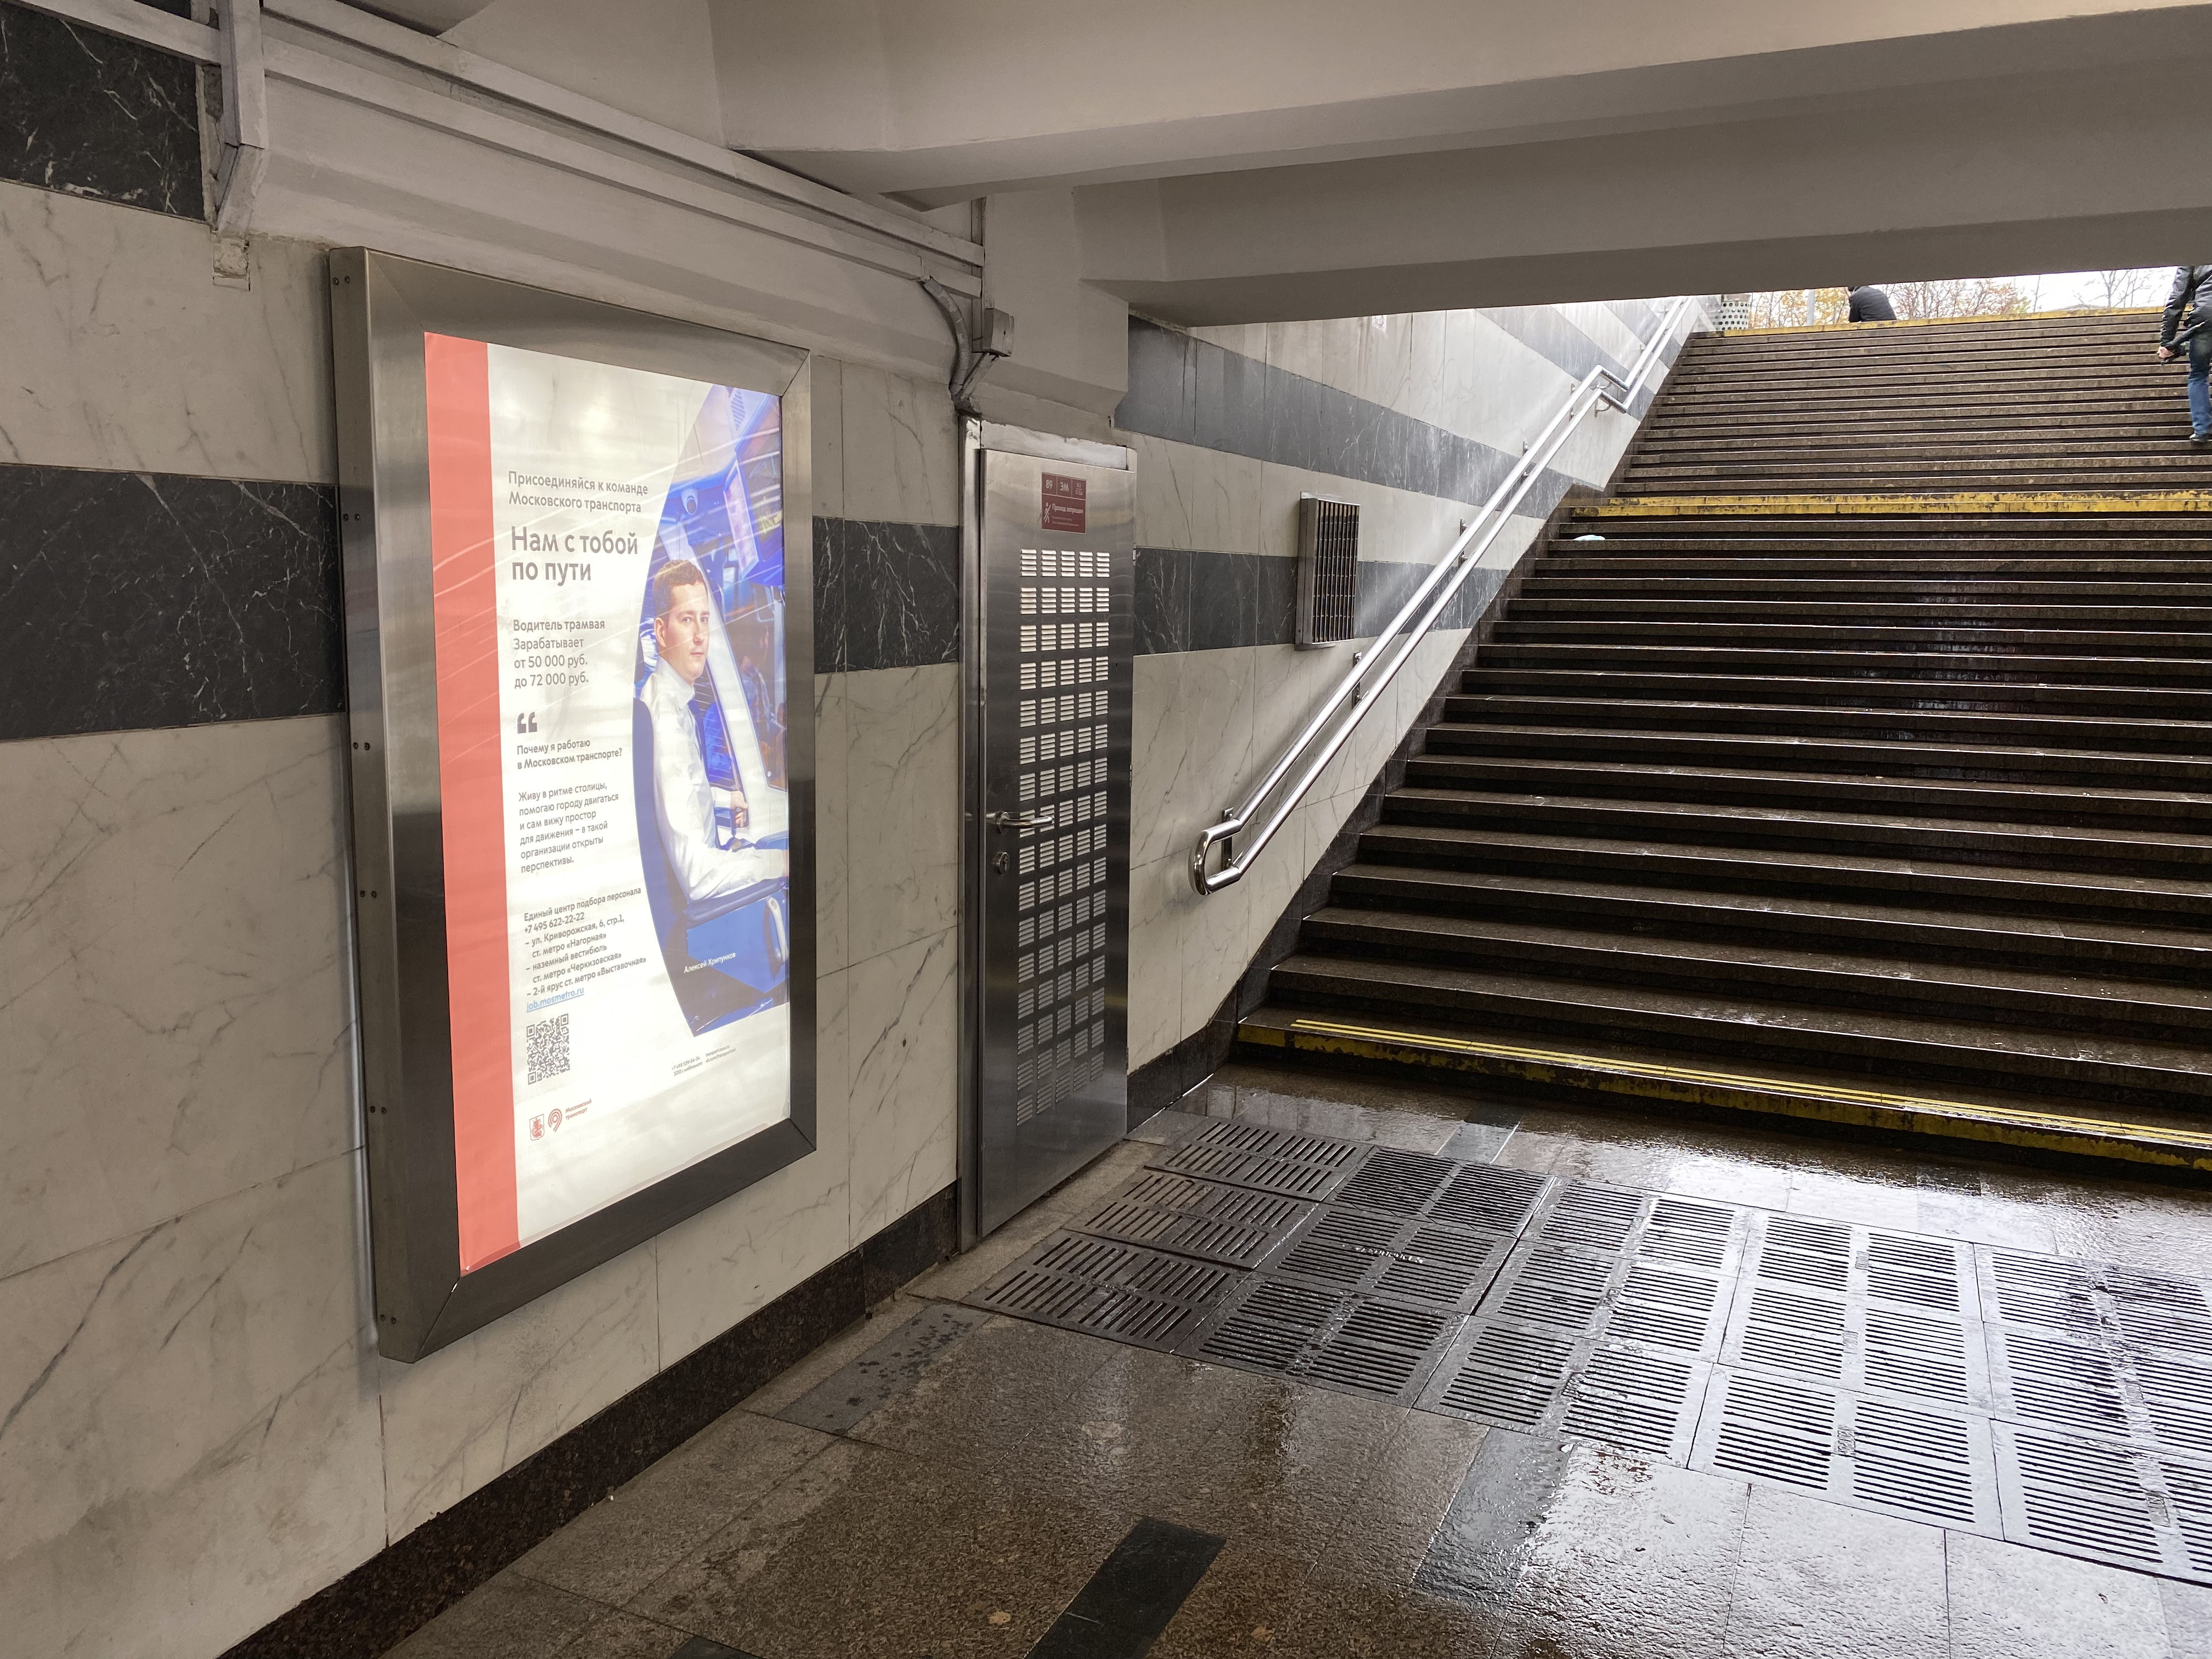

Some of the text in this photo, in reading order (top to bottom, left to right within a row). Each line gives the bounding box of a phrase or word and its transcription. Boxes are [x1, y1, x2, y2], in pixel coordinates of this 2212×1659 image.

[509, 471, 648, 496] Присоединяйся к команде
[1046, 479, 1052, 489] 89
[509, 492, 641, 514] Московского транспорта
[511, 526, 637, 554] Нам с тобой
[512, 562, 591, 586] по пути
[513, 619, 605, 633] Водитель трамвая
[514, 637, 584, 652] Зарабатывает
[515, 653, 588, 668] от 50 000 руб.
[515, 672, 588, 689] до 72 000 руб.
[517, 744, 548, 755] Почему
[557, 740, 590, 752] работаю
[524, 756, 575, 769] Московском
[577, 748, 622, 763] транспорте?
[518, 792, 540, 802] Живу
[549, 787, 572, 799] ритме
[575, 783, 607, 793] столицы,
[520, 794, 618, 816] помогаю городу двигаться
[527, 820, 541, 828] сам
[544, 816, 563, 828] вижу
[566, 811, 596, 822] простор
[520, 836, 533, 846] для
[535, 829, 573, 843] движения
[588, 821, 607, 832] такой
[521, 837, 603, 860] организации открыты
[521, 856, 574, 873] перспективы.
[524, 888, 641, 922] Единый центр подбора персонала
[524, 912, 584, 934] +7 495 622-22-22
[532, 938, 542, 947] ул.
[544, 923, 597, 943] Криворожская,
[543, 943, 565, 955] метро
[567, 933, 607, 949] «Нагорная»
[533, 953, 568, 970] наземный
[571, 945, 607, 960] вестибюль
[544, 968, 565, 980] метро
[567, 953, 621, 973] «Черкизовская»
[684, 952, 736, 973] Алексей Хрипунков
[533, 986, 545, 996] 2-й
[547, 981, 563, 992] ярус
[575, 972, 596, 983] метро
[597, 957, 646, 977] «Выставочная»
[526, 988, 584, 1012] job.mosmetro.ru
[566, 1099, 591, 1120] Московский транспорт
